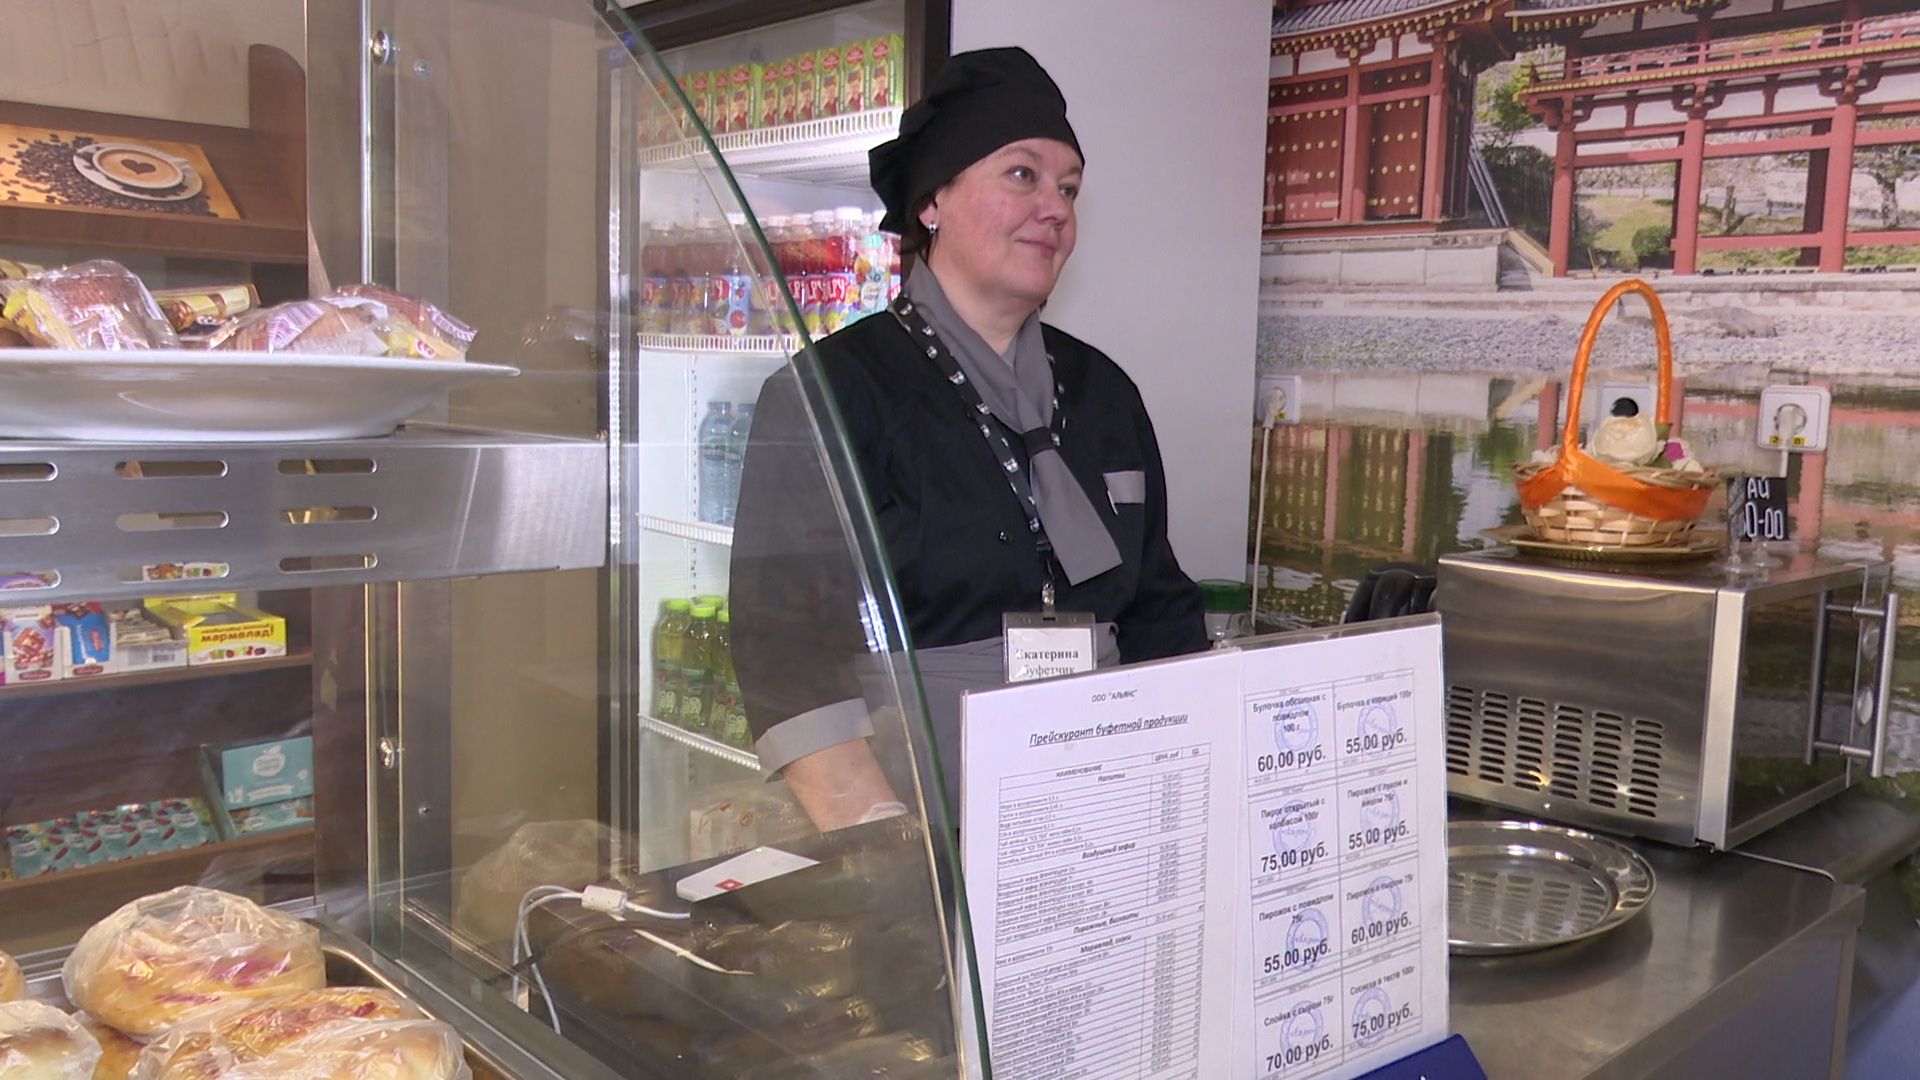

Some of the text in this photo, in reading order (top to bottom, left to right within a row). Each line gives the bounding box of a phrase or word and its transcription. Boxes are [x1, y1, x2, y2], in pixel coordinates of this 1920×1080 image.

[1744, 501, 1784, 540] 0-00
[201, 624, 274, 643] мармелад!
[1091, 694, 1106, 703] ООО
[1253, 701, 1284, 713] Булочка
[1337, 700, 1365, 712] Булочка
[1029, 713, 1189, 746] Прейскурант буфетной продукции
[1283, 723, 1295, 733] 100
[1346, 727, 1407, 754] 55,00 руб.
[1258, 744, 1327, 772] 60,00 руб.
[1348, 786, 1376, 799] Пирожок
[1261, 807, 1282, 819] Пирог
[1284, 798, 1320, 814] открытый
[1269, 816, 1303, 830] колбасой
[1348, 820, 1410, 850] 55,00 руб.
[1261, 841, 1329, 873] 75,00 руб.
[1346, 886, 1374, 901] Пирожок
[1259, 906, 1291, 922] Пирожок
[1298, 894, 1334, 909] повидлом
[1351, 911, 1412, 945] 60,00 руб.
[1264, 937, 1332, 974] 55,00 руб.
[1350, 980, 1376, 996] Сосиска
[1383, 972, 1400, 983] тесте
[1264, 1011, 1291, 1027] Слойка
[1297, 1000, 1321, 1014] сыром
[1352, 1002, 1413, 1039] 75,00 руб.
[1266, 1033, 1333, 1073] 70,00 руб.
